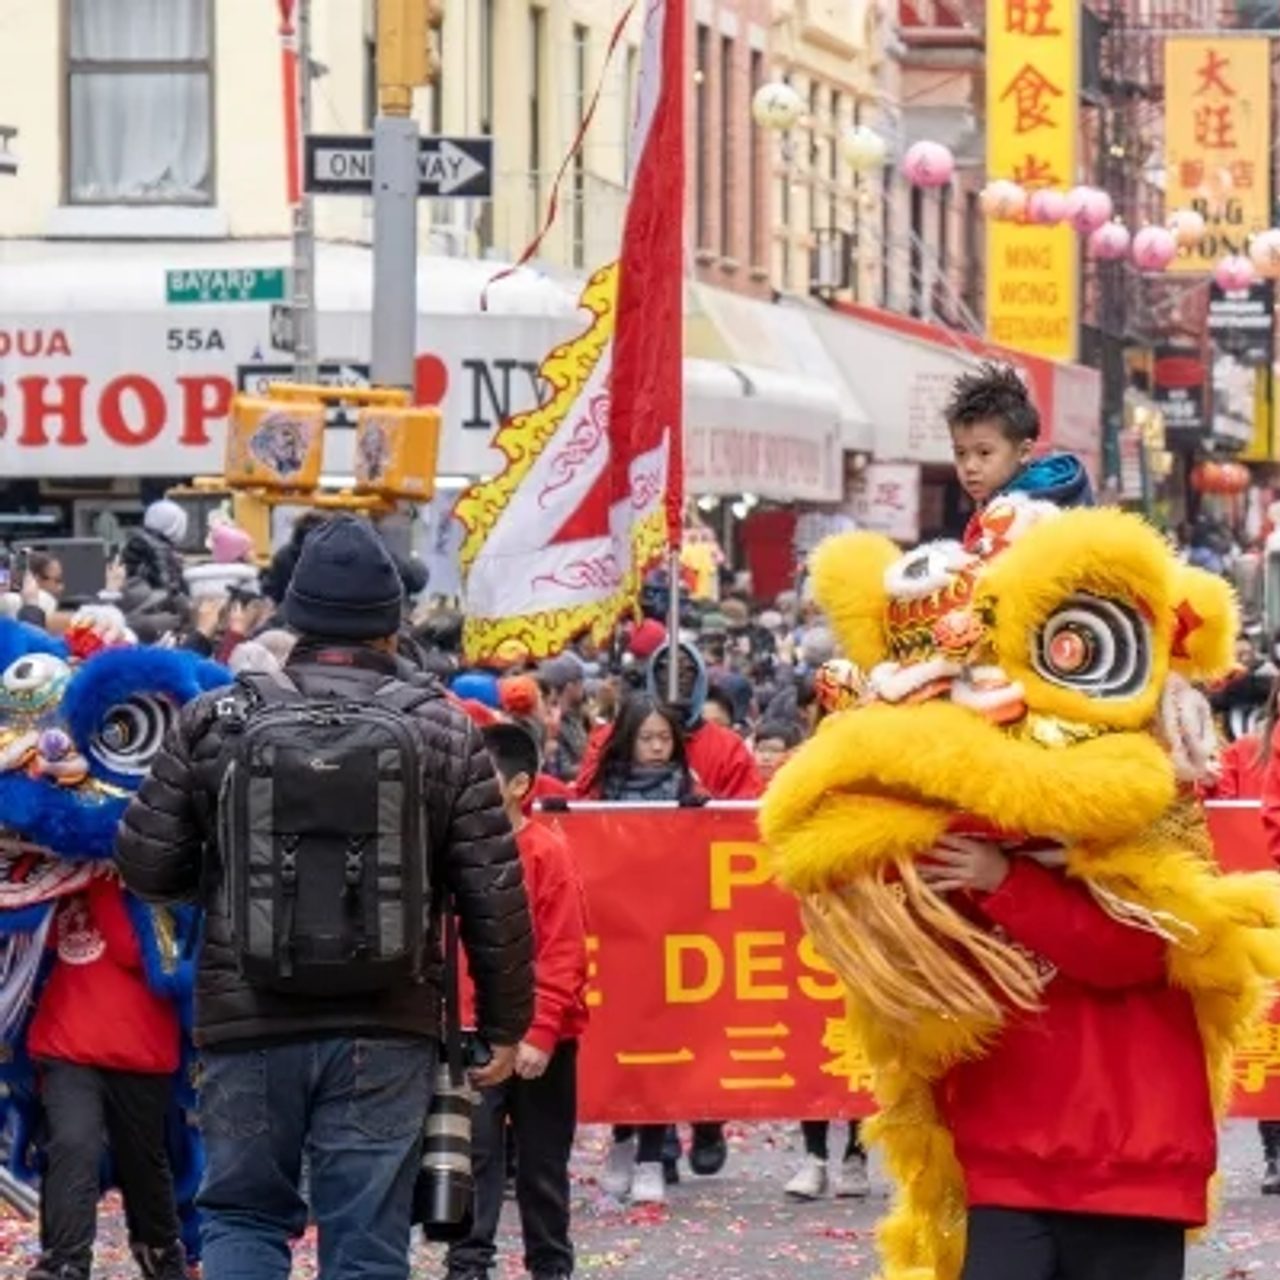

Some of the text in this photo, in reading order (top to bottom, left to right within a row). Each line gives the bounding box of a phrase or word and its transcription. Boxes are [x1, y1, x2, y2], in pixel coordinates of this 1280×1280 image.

[1194, 48, 1237, 149] 大旺
[1192, 198, 1242, 225] BG
[171, 269, 256, 291] BAYARD
[999, 281, 1058, 306] WONG
[166, 328, 226, 351] 55A
[0, 374, 235, 447] HOP
